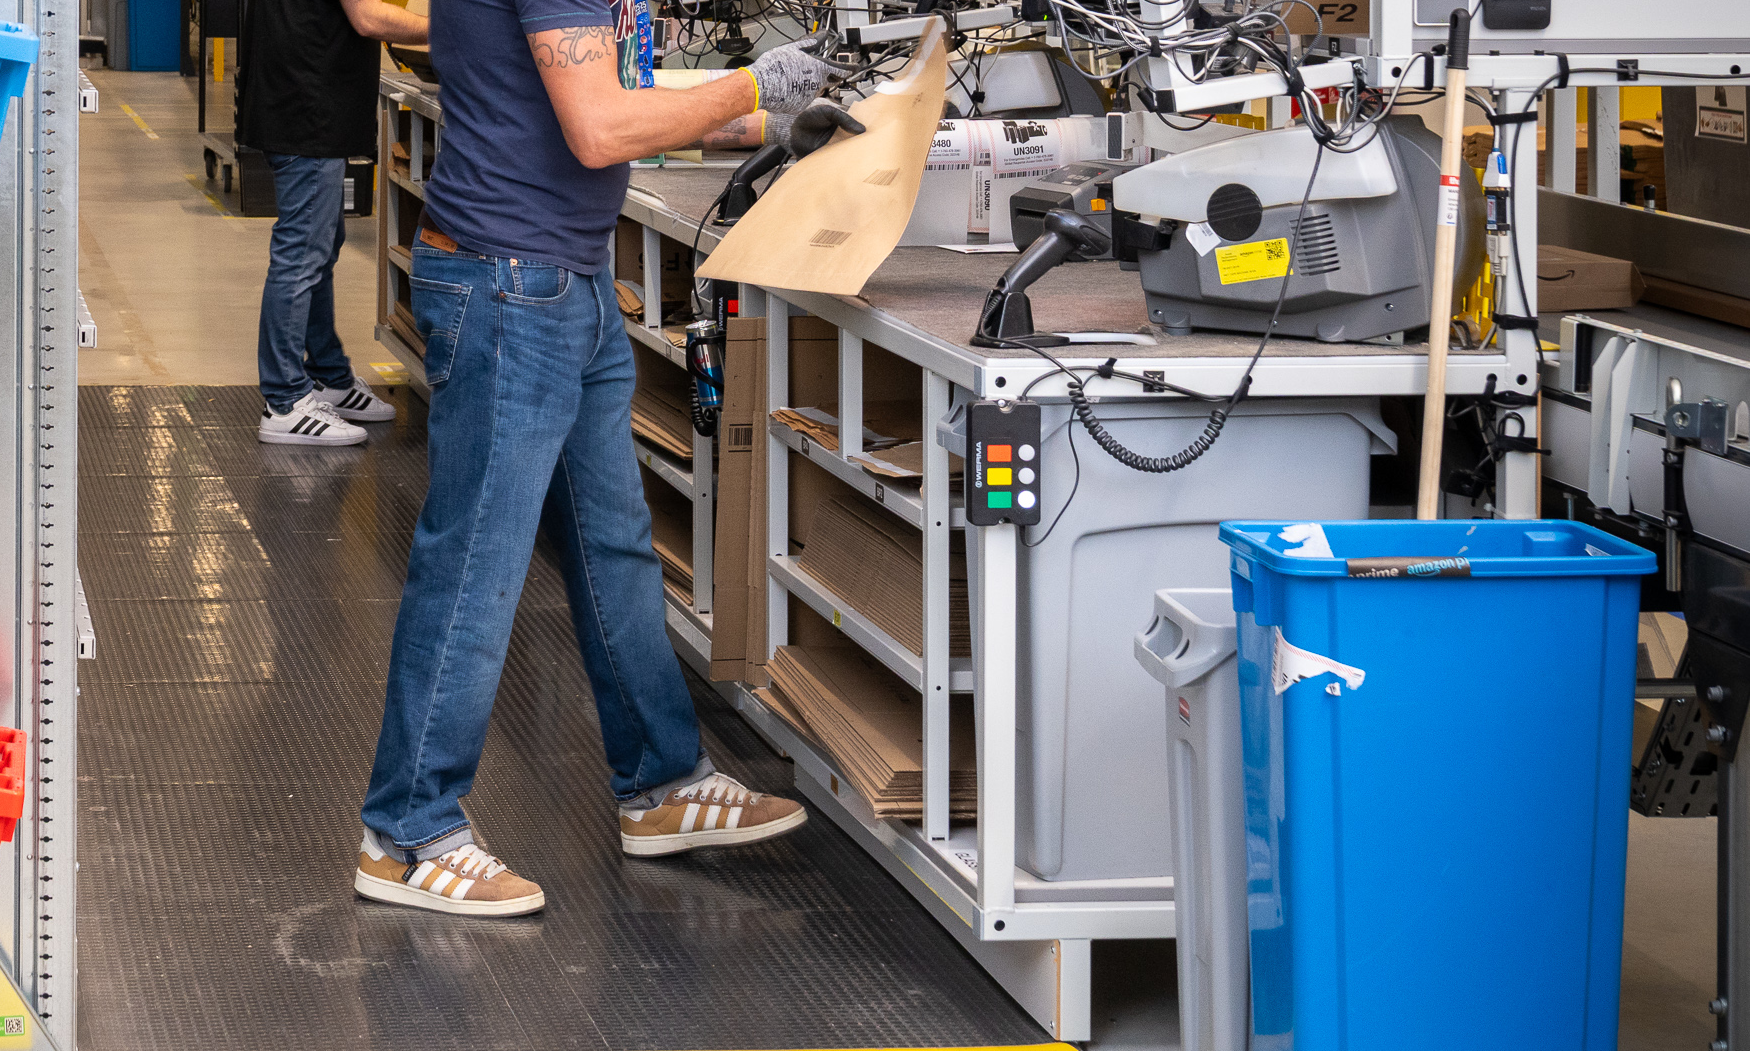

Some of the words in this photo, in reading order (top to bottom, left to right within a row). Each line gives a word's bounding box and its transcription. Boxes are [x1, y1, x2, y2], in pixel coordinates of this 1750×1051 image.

[1314, 3, 1358, 23] F2
[791, 79, 820, 94] HyFlex
[931, 139, 951, 148] 3480
[1013, 145, 1044, 156] UN3091
[1406, 558, 1456, 575] amazon
[402, 863, 416, 881] CAMPUS
